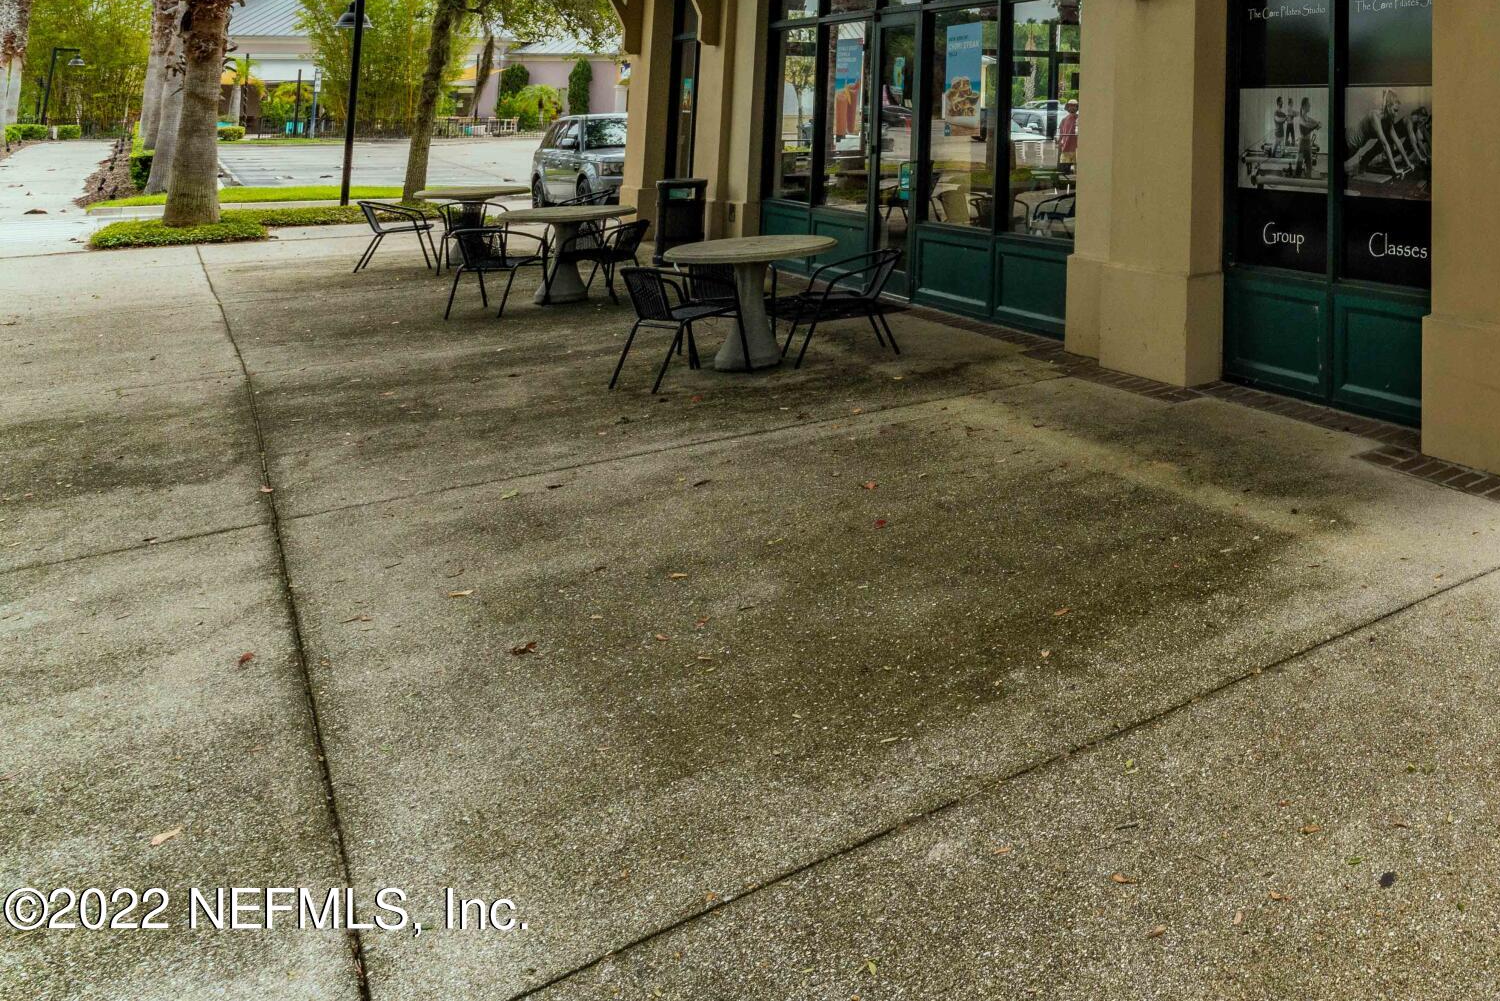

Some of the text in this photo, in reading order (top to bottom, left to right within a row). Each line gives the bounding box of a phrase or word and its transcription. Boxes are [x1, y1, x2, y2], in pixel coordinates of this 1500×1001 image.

[1248, 4, 1326, 21] The Core Pilates Studio
[1354, 0, 1371, 14] The
[1263, 221, 1305, 254] Group
[1368, 232, 1428, 259] Classes
